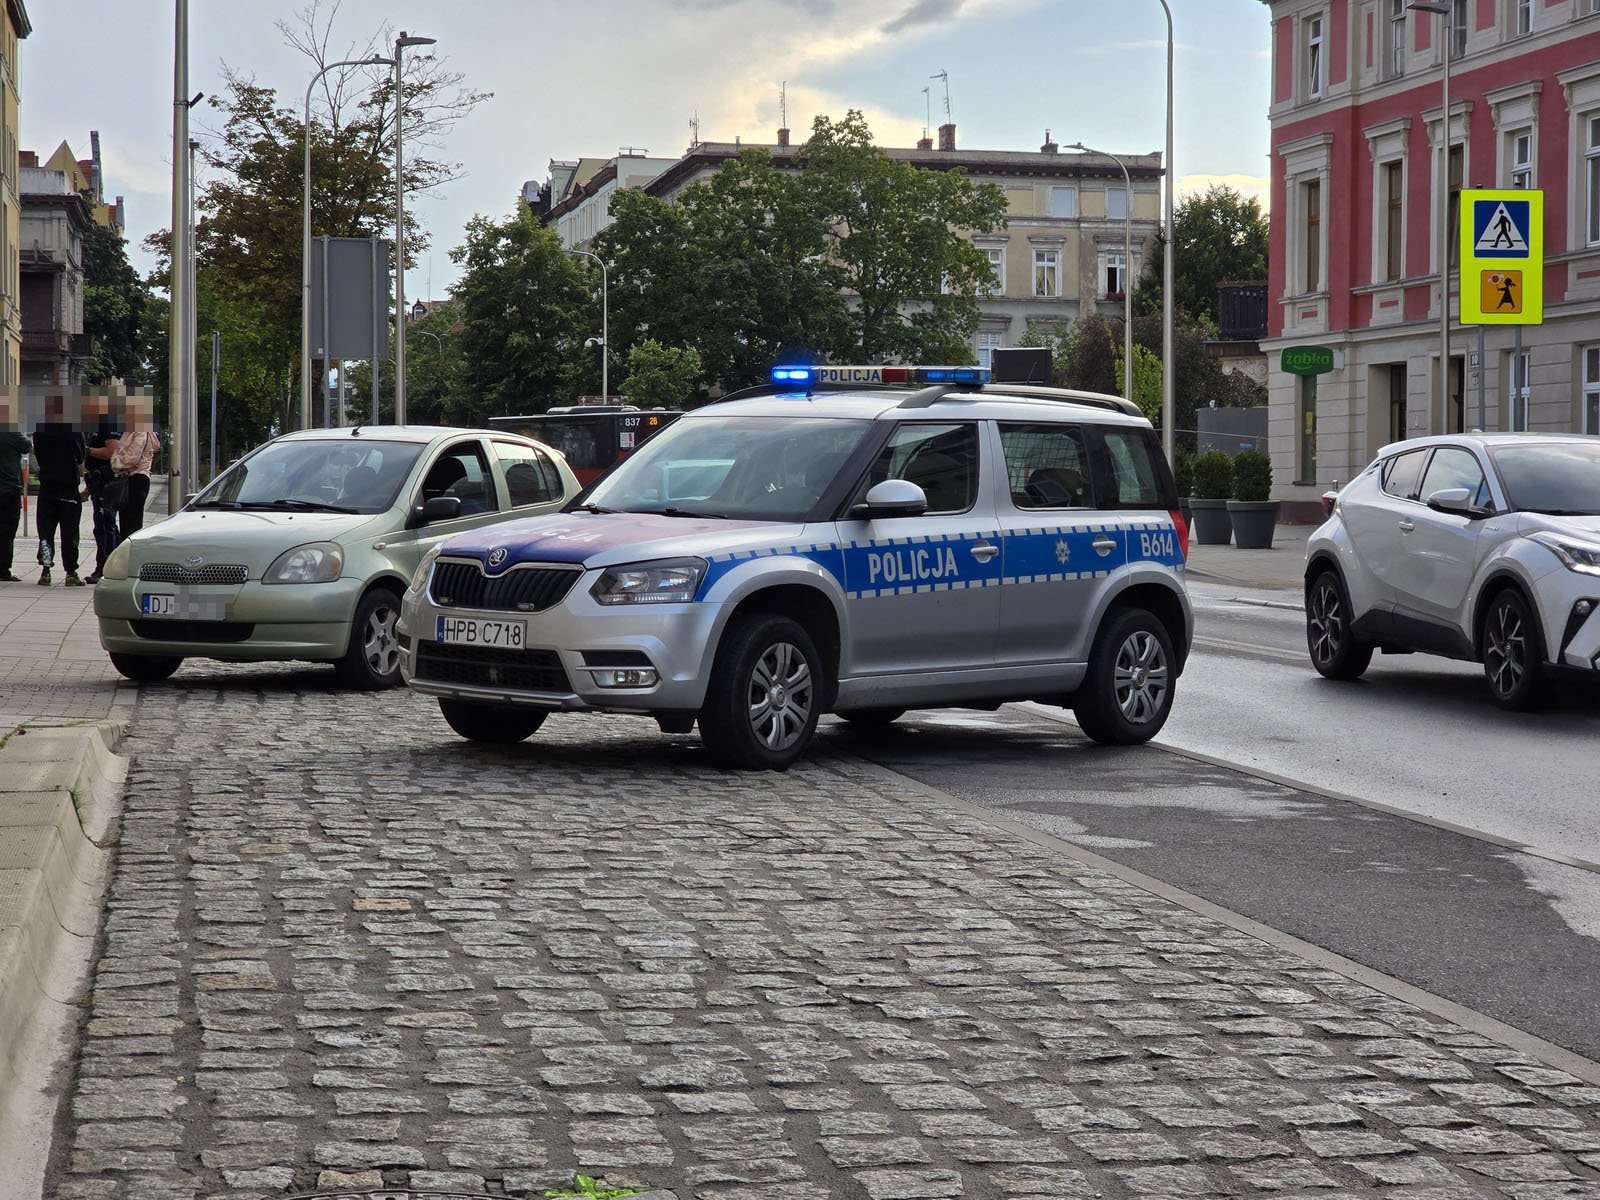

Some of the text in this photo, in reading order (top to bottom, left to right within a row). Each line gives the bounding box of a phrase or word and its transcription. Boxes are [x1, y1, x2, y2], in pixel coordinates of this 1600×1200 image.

[820, 368, 881, 382] POLICJA
[624, 417, 640, 427] 837
[649, 416, 658, 426] 26
[1140, 533, 1174, 557] B614
[868, 548, 959, 583] POLICJA
[445, 619, 521, 646] HPB C718
